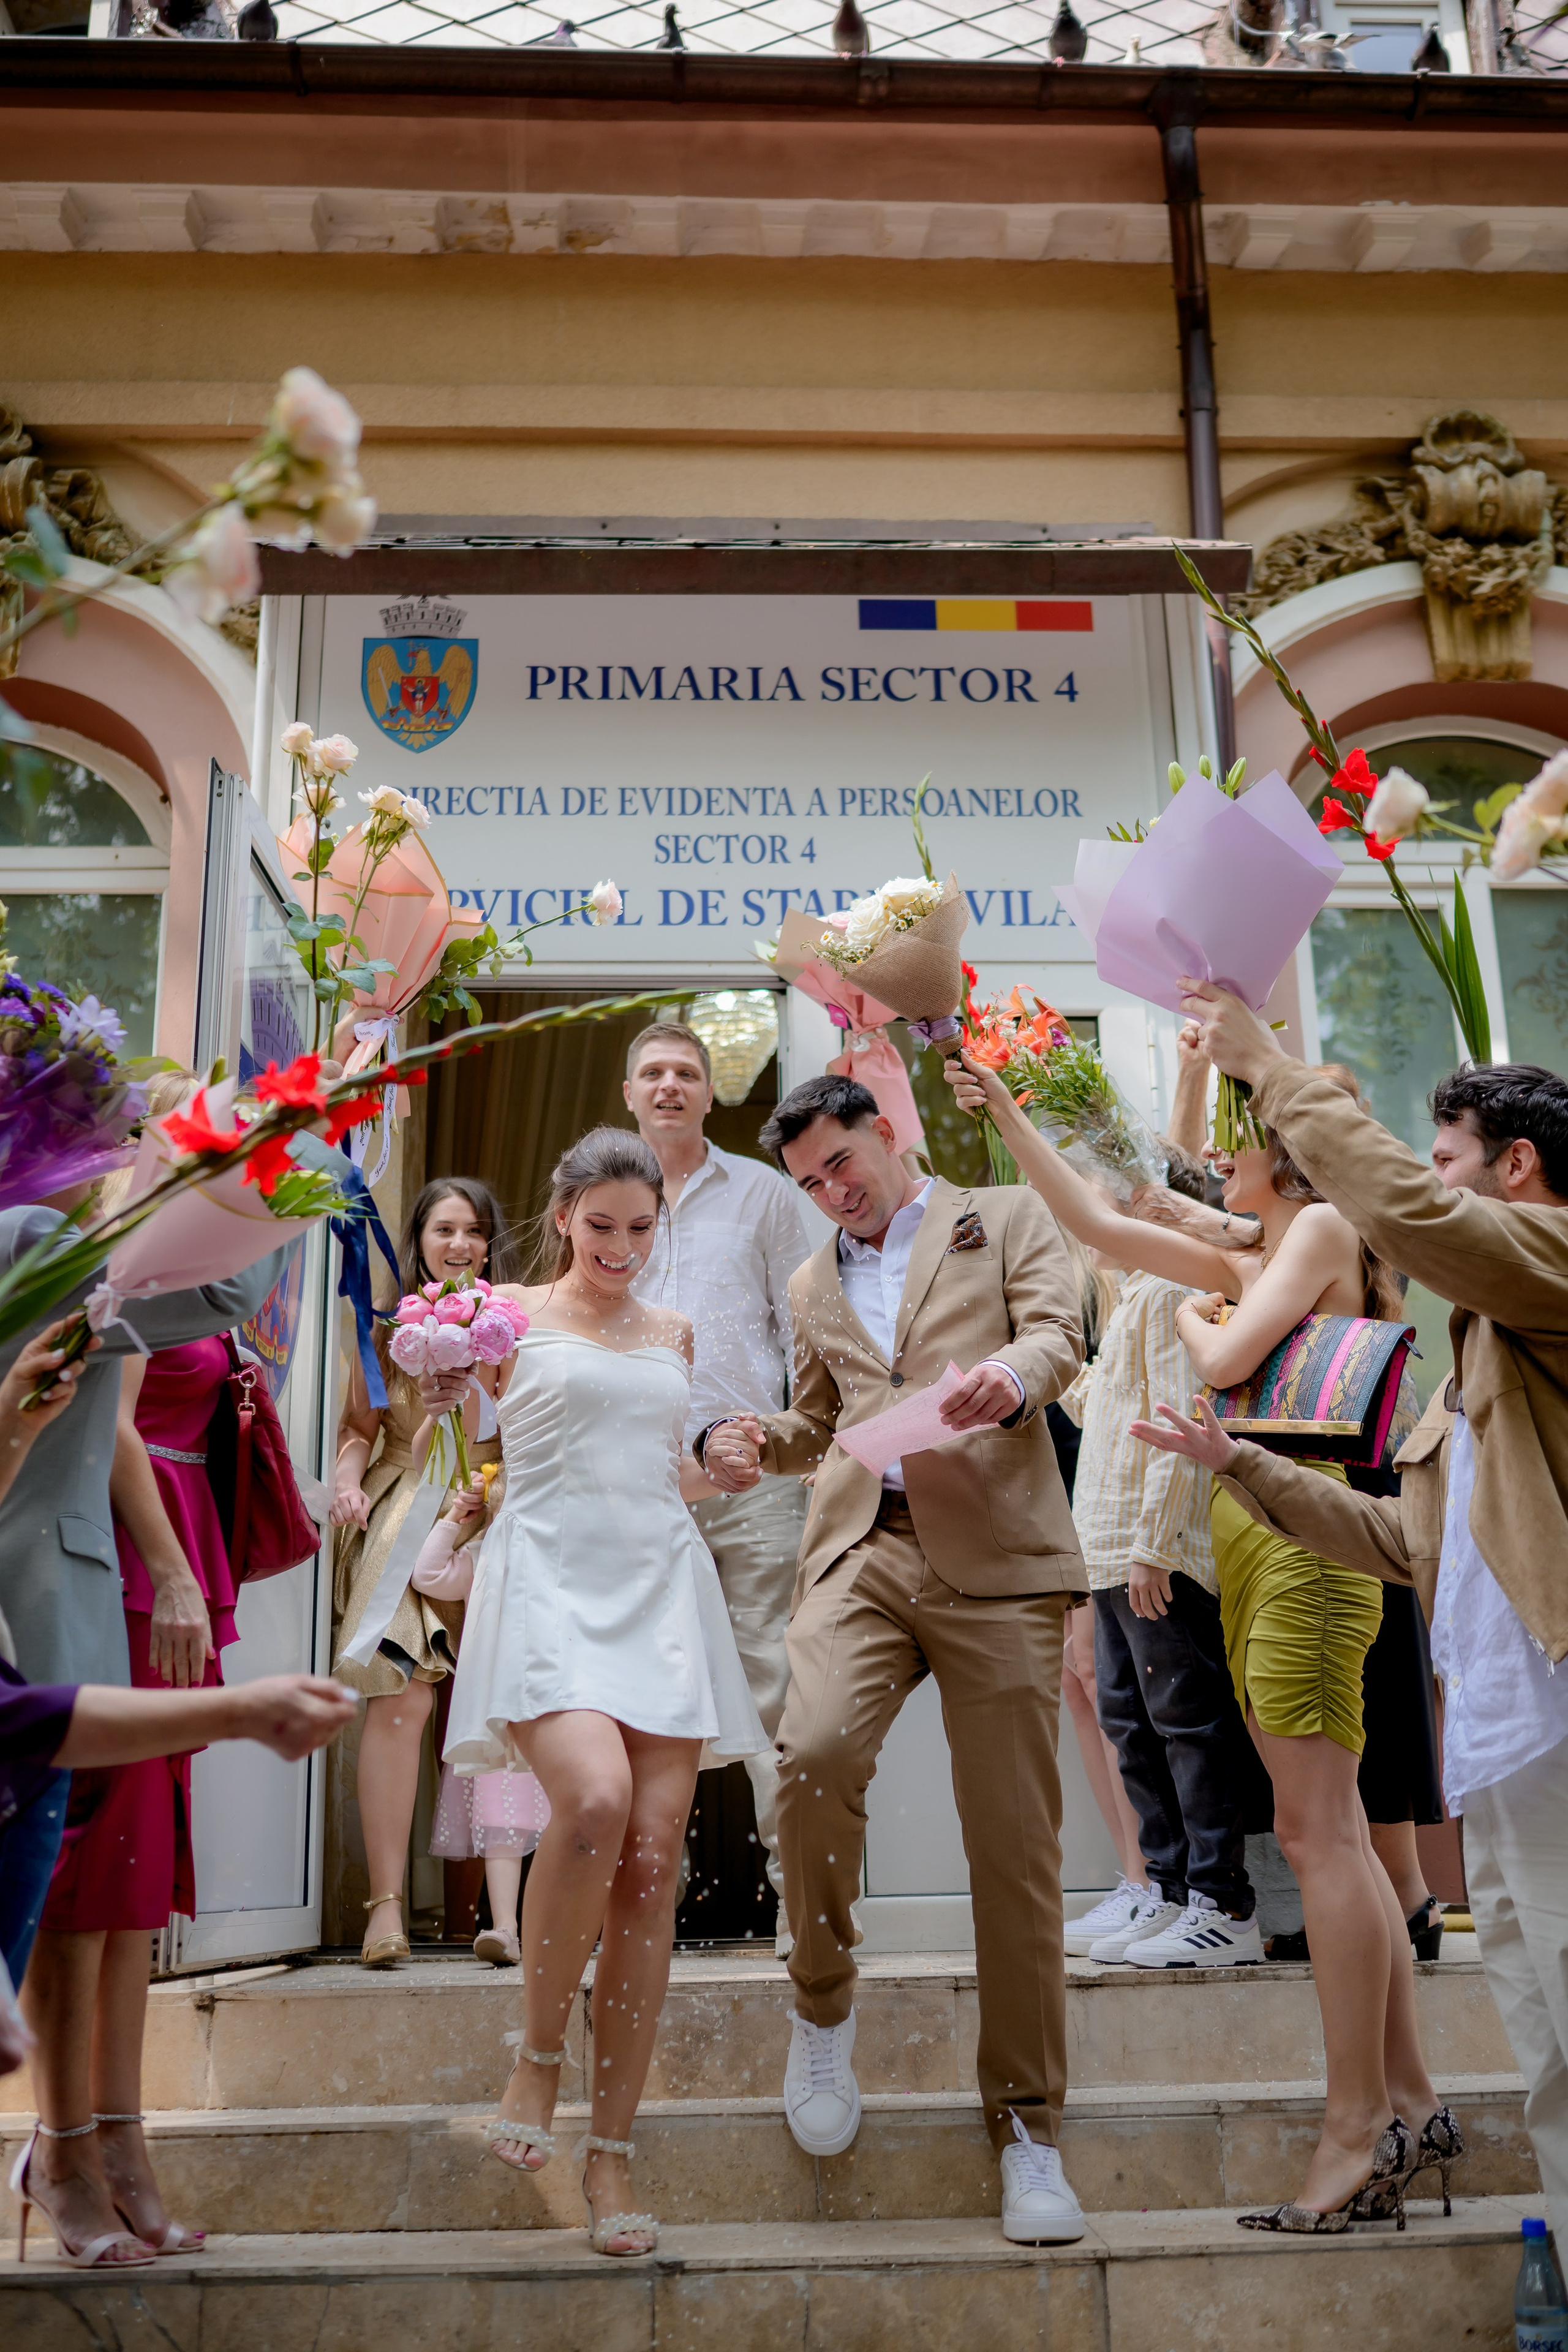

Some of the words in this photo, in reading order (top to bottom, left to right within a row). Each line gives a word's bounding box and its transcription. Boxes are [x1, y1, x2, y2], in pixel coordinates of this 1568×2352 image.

[526, 665, 805, 701] PRIMARIA
[821, 666, 1039, 703] SECTOR
[1054, 671, 1079, 703] 4
[562, 787, 608, 816] DE
[618, 787, 796, 816] EVIDENTA
[805, 788, 829, 816] A
[839, 788, 1083, 818] PERSOANELOR
[654, 834, 791, 864] SECTOR
[800, 837, 816, 864] 4
[658, 889, 728, 927] DE
